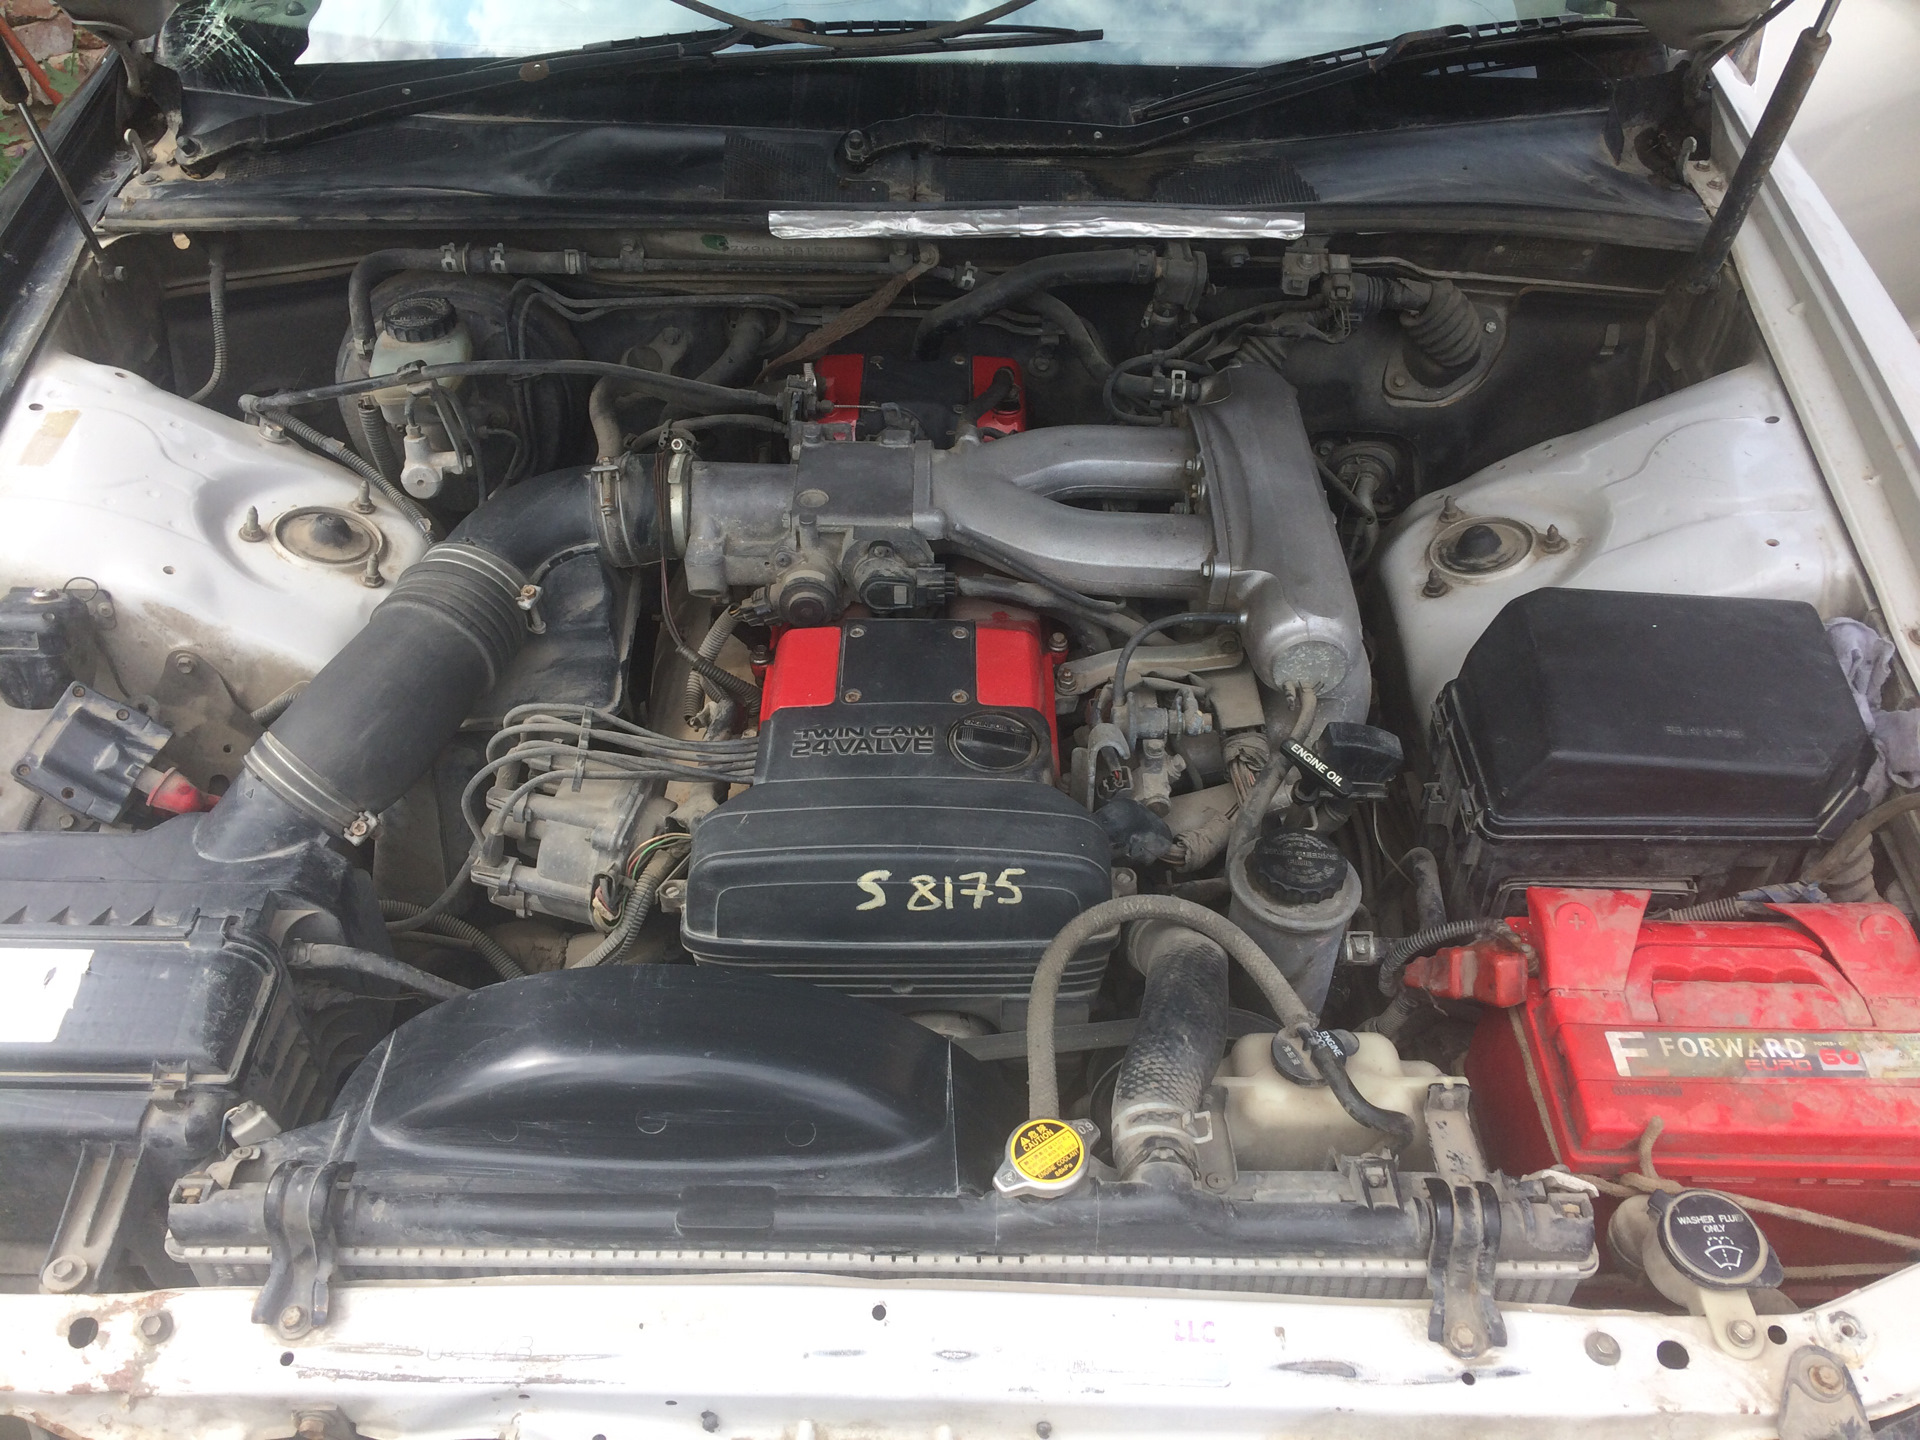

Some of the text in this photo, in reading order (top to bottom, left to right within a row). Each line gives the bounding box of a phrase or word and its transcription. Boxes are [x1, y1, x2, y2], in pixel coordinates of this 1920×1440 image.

[793, 725, 934, 739] TWIN CAM
[790, 737, 934, 758] 24VALVE
[1291, 743, 1343, 787] ENGINE OIL
[1320, 1030, 1344, 1057] ENGINE
[1658, 1037, 1807, 1059] FORWARD
[1744, 1059, 1813, 1071] EURO
[1818, 1048, 1860, 1066] 60
[1078, 1122, 1094, 1135] 0.9
[1023, 1129, 1055, 1152] CAUTION
[1056, 1148, 1080, 1166] COOLANT
[1677, 1214, 1744, 1225] WASHER FLUID
[1703, 1224, 1726, 1233] ONLY
[1174, 1319, 1216, 1343] LLC
